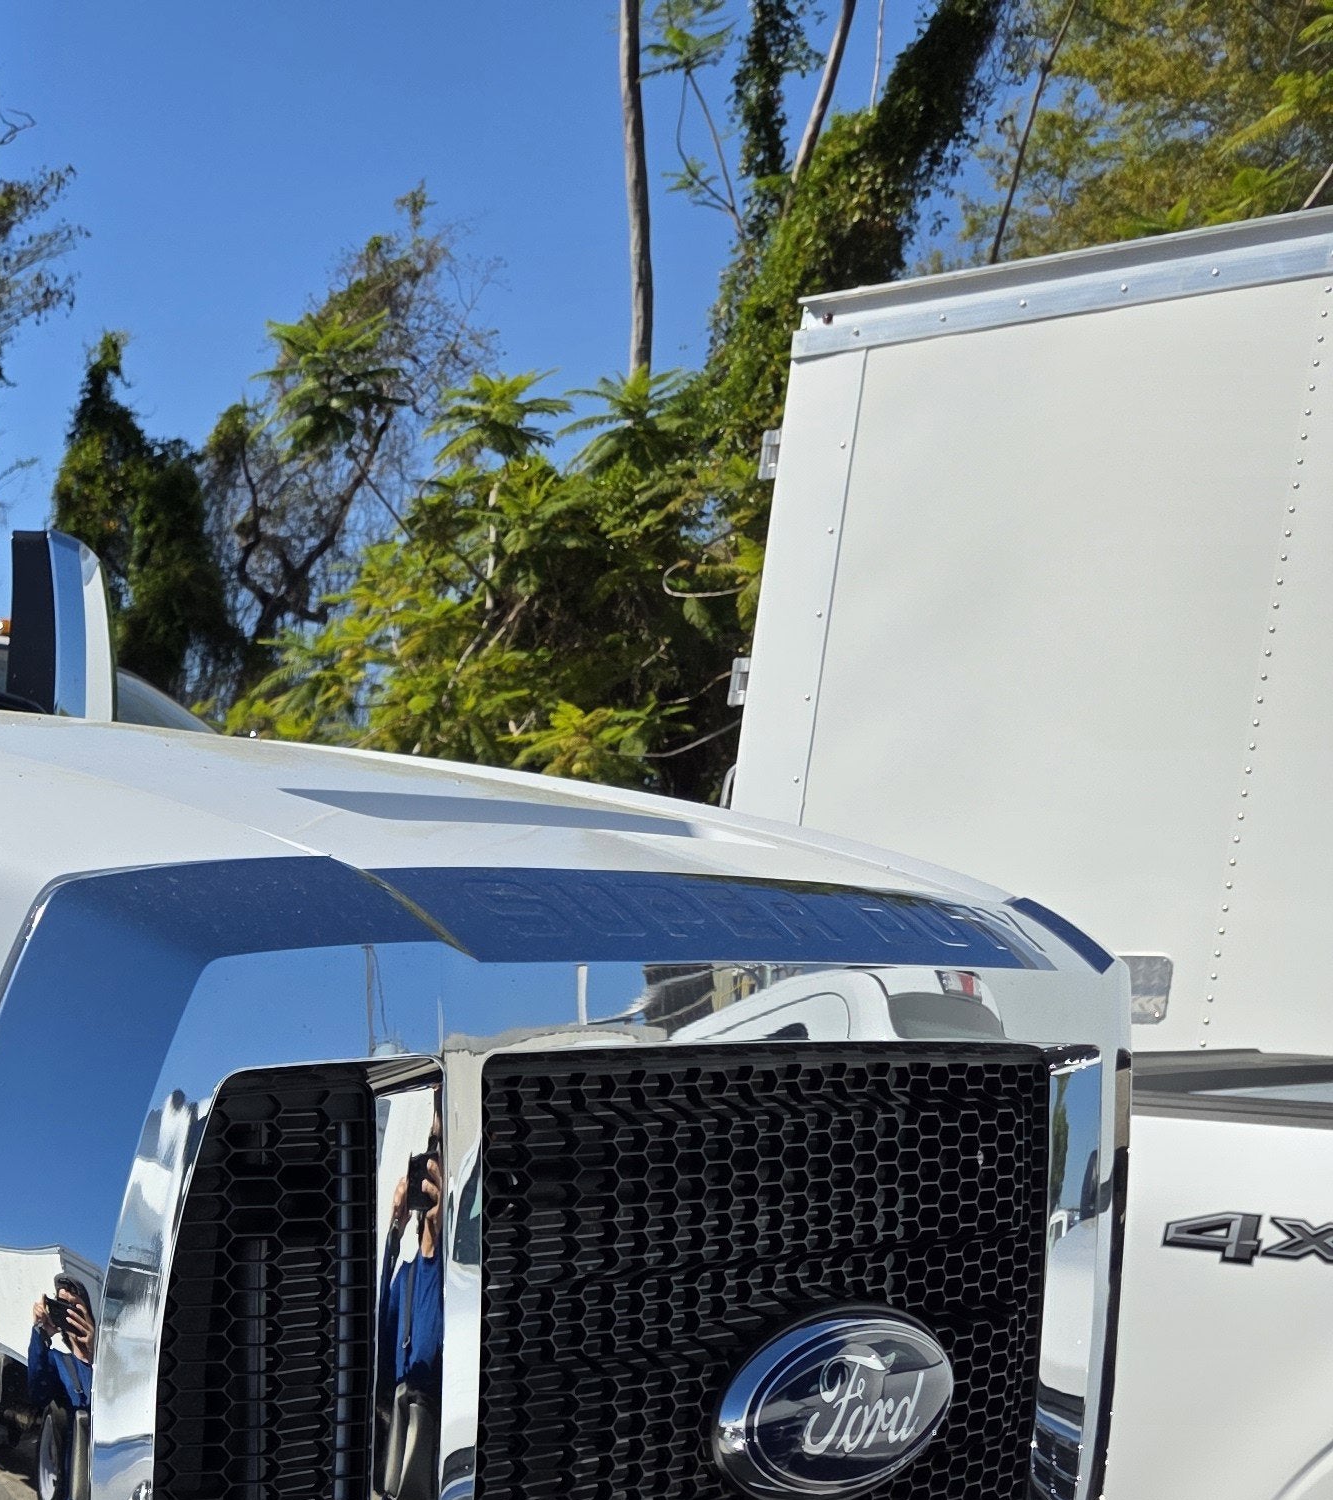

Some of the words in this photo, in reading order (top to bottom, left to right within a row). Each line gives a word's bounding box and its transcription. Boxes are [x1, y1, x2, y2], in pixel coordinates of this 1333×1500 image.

[463, 876, 841, 943] SUPER
[837, 889, 1046, 954] DUTY
[802, 1352, 923, 1456] Ford
